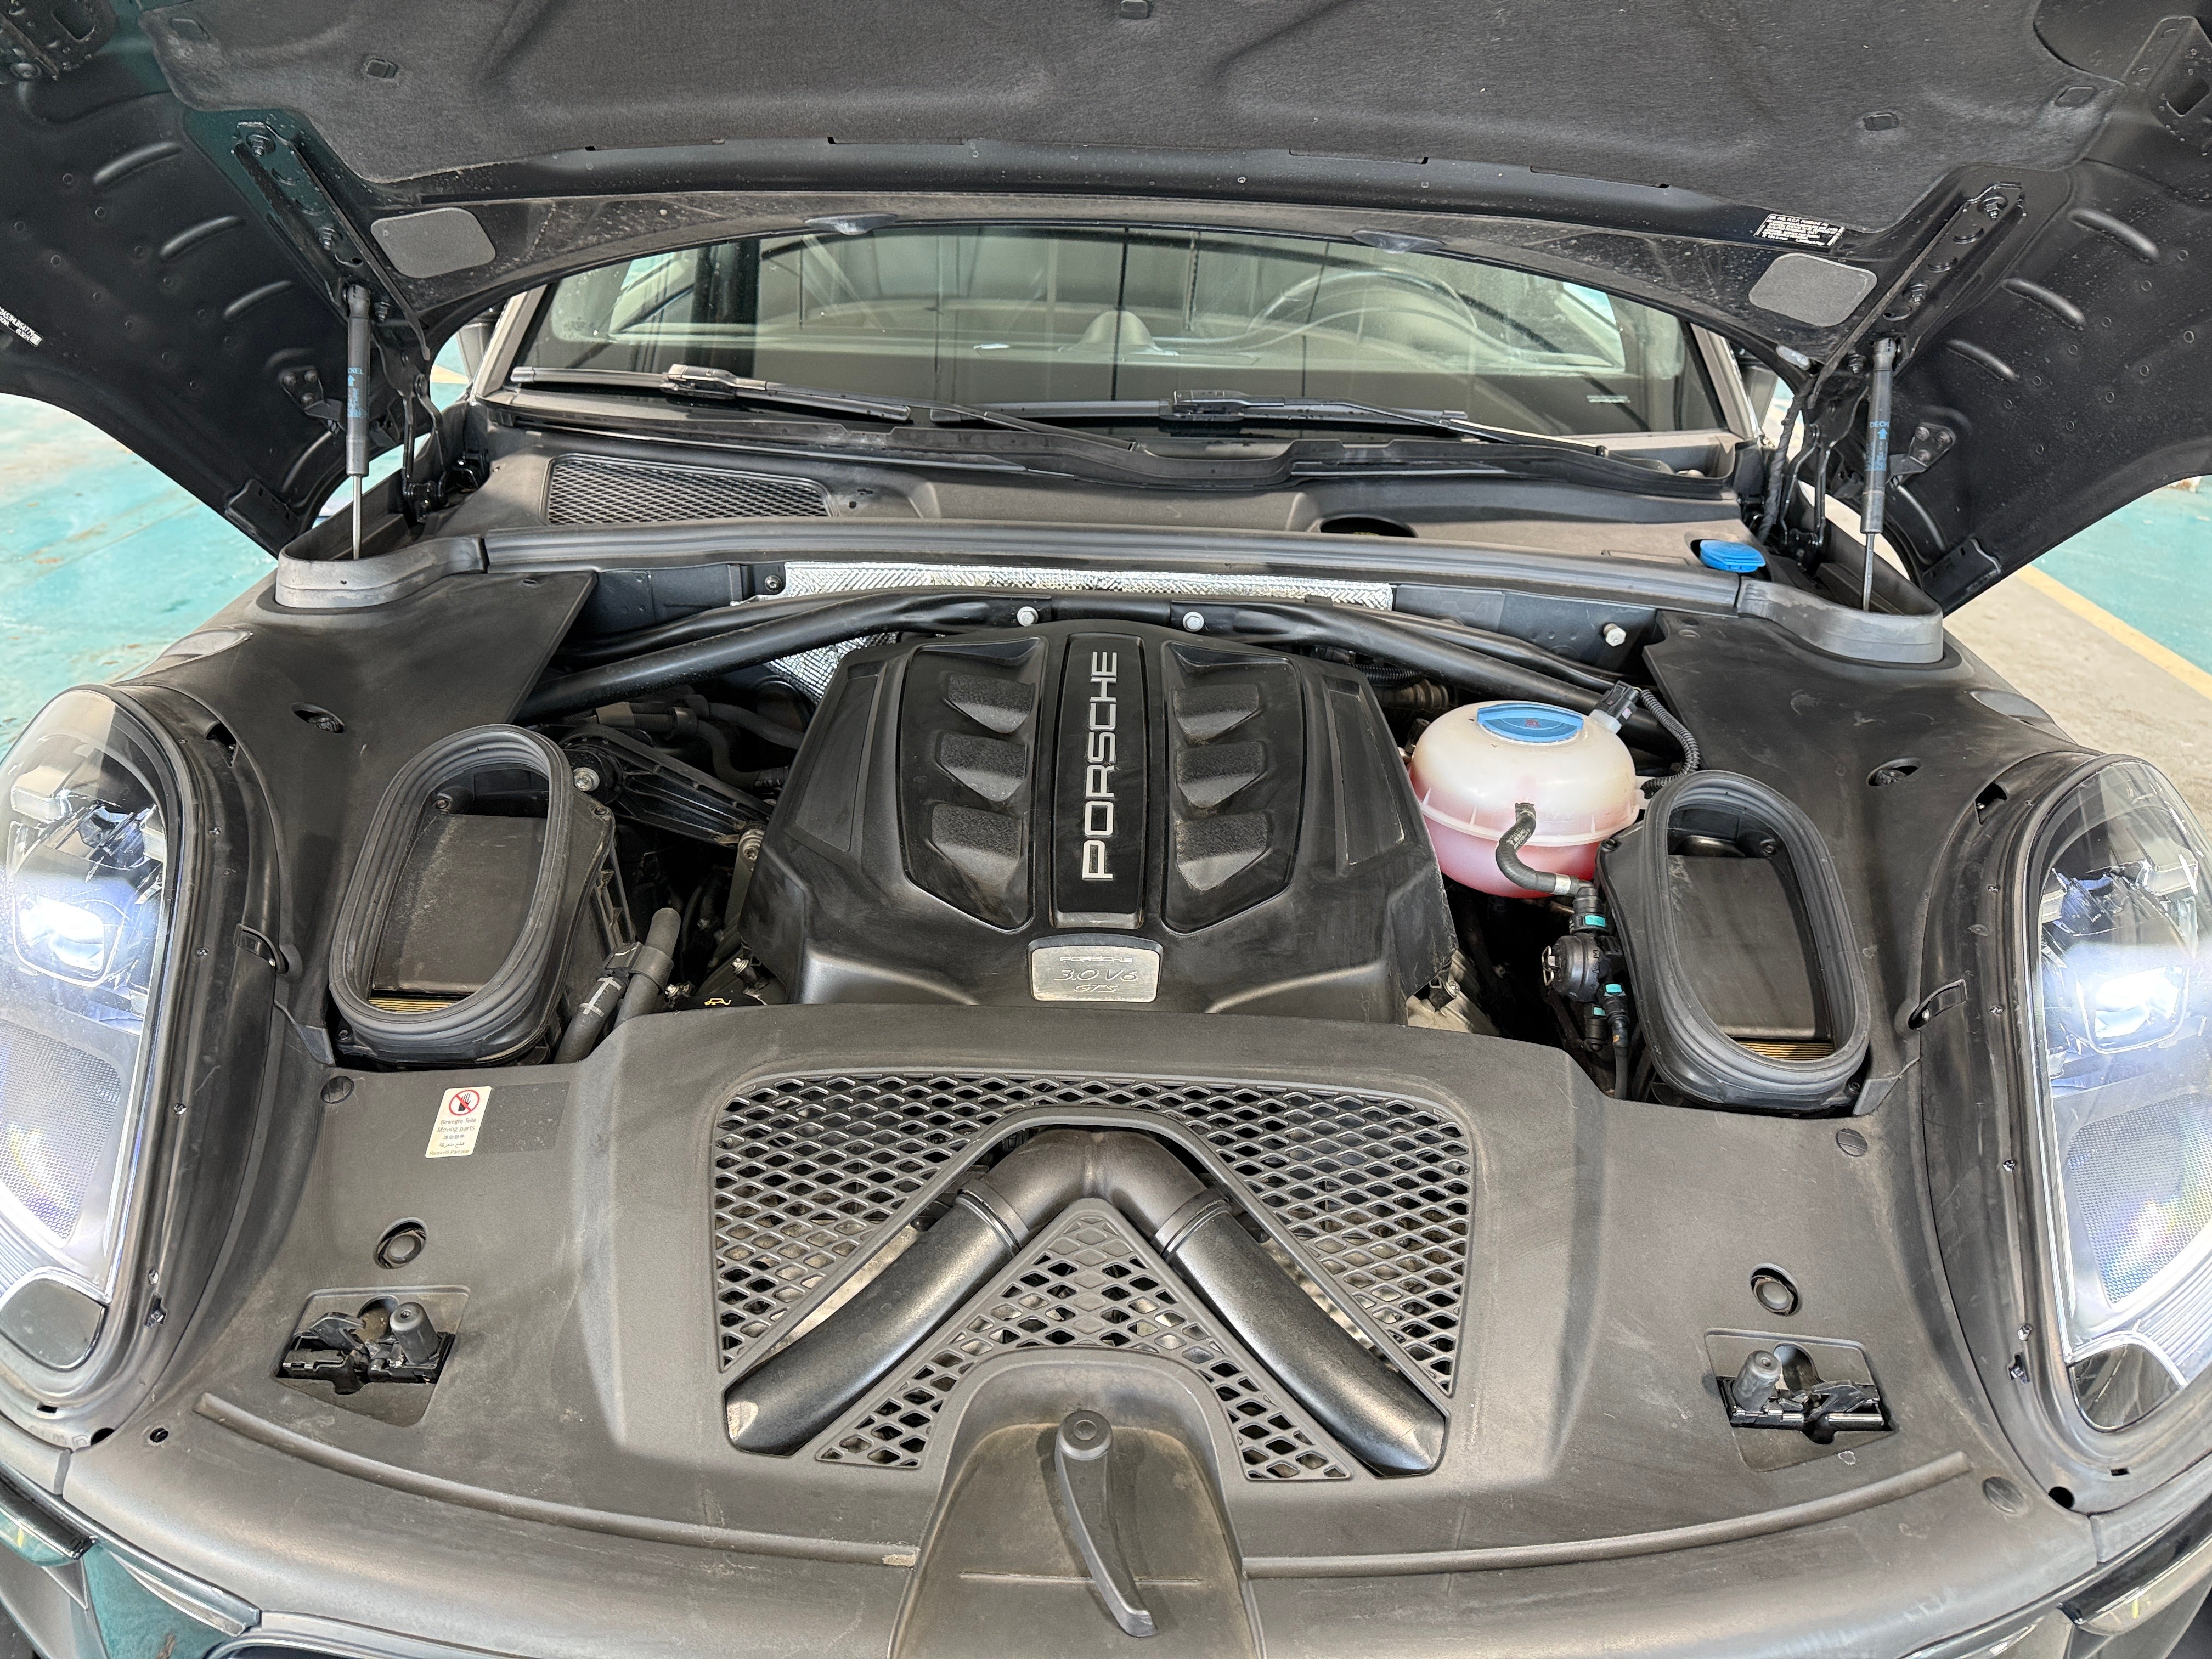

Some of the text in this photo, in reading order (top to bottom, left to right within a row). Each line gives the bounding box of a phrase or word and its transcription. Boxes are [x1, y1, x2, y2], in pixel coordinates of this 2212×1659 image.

[1081, 651, 1118, 881] PORSCHE
[1053, 968, 1138, 982] 3.0 V6
[1073, 984, 1119, 993] GTS
